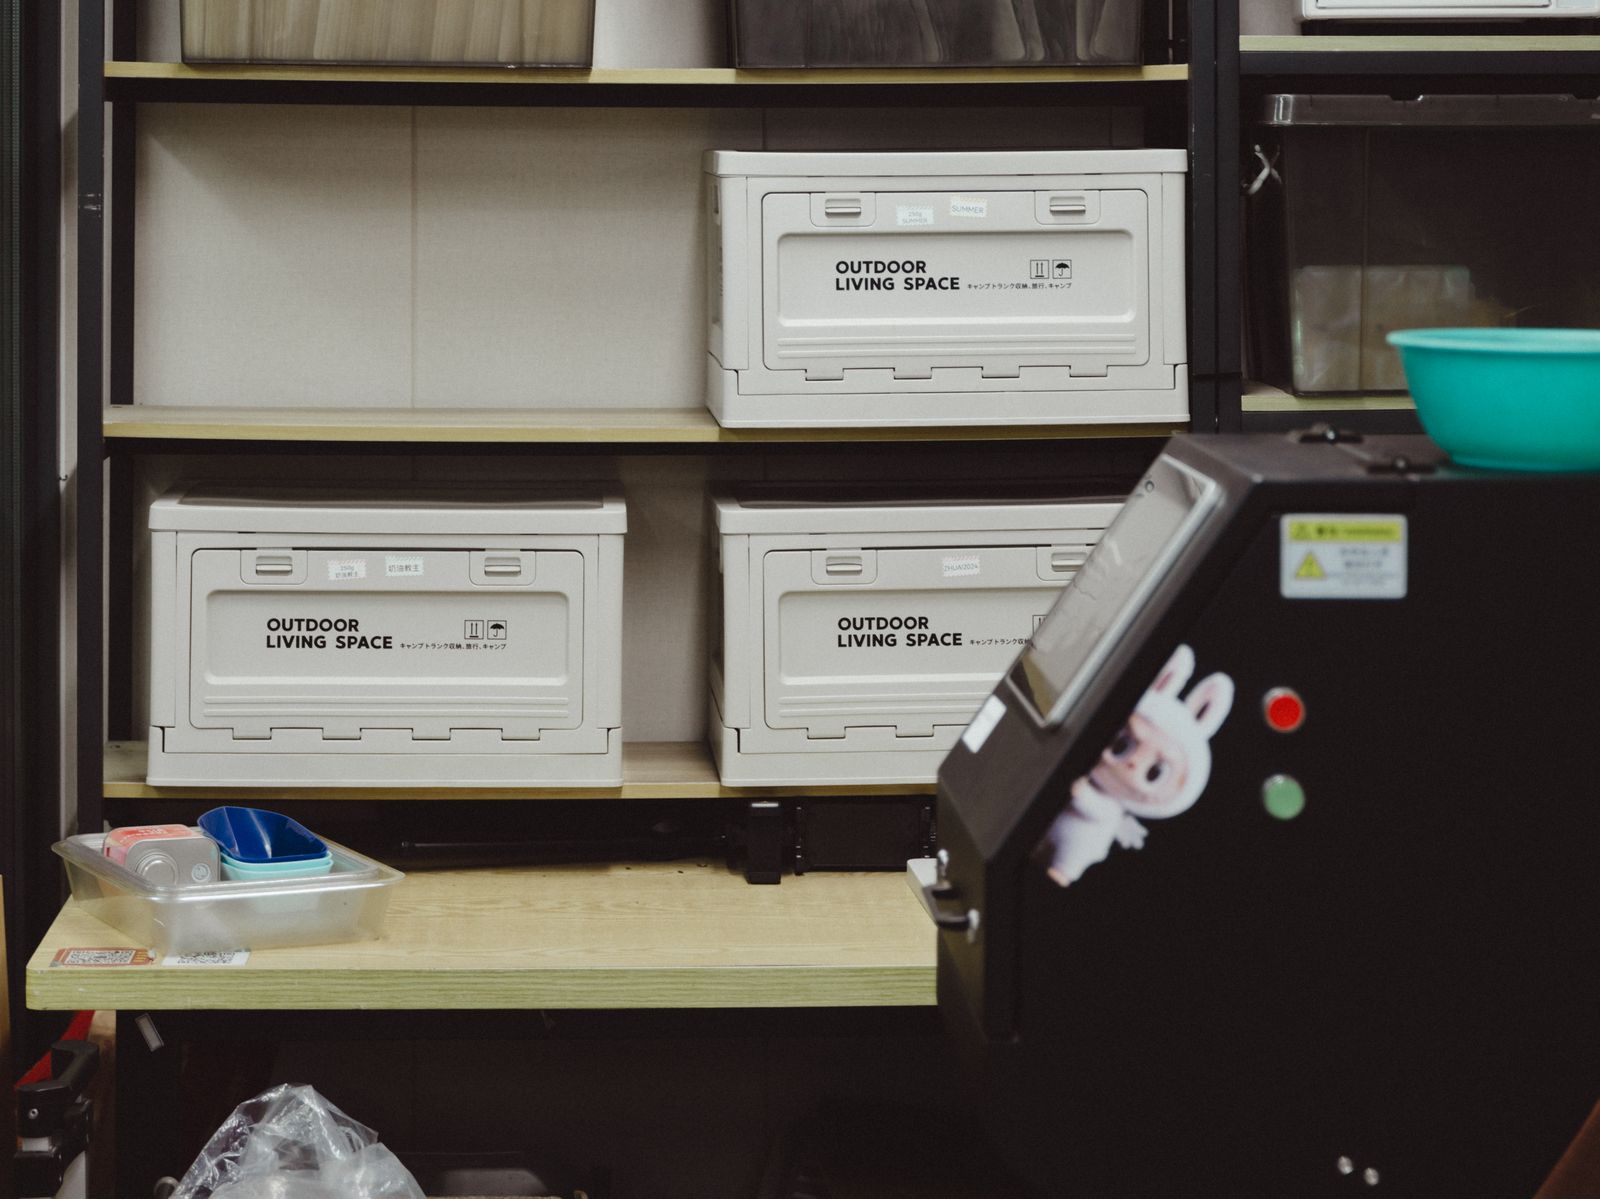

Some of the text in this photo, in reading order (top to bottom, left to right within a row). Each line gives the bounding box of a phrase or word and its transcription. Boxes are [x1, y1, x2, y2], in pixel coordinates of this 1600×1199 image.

[951, 204, 985, 214] SUMMER
[835, 260, 927, 274] OUTDOOR
[835, 277, 960, 291] LIVING SPACE
[267, 618, 359, 632] OUTDOOR
[838, 616, 929, 630] OUTDOOR
[266, 635, 392, 649] LIVING SPACE
[838, 633, 962, 648] LIVING SPACE
